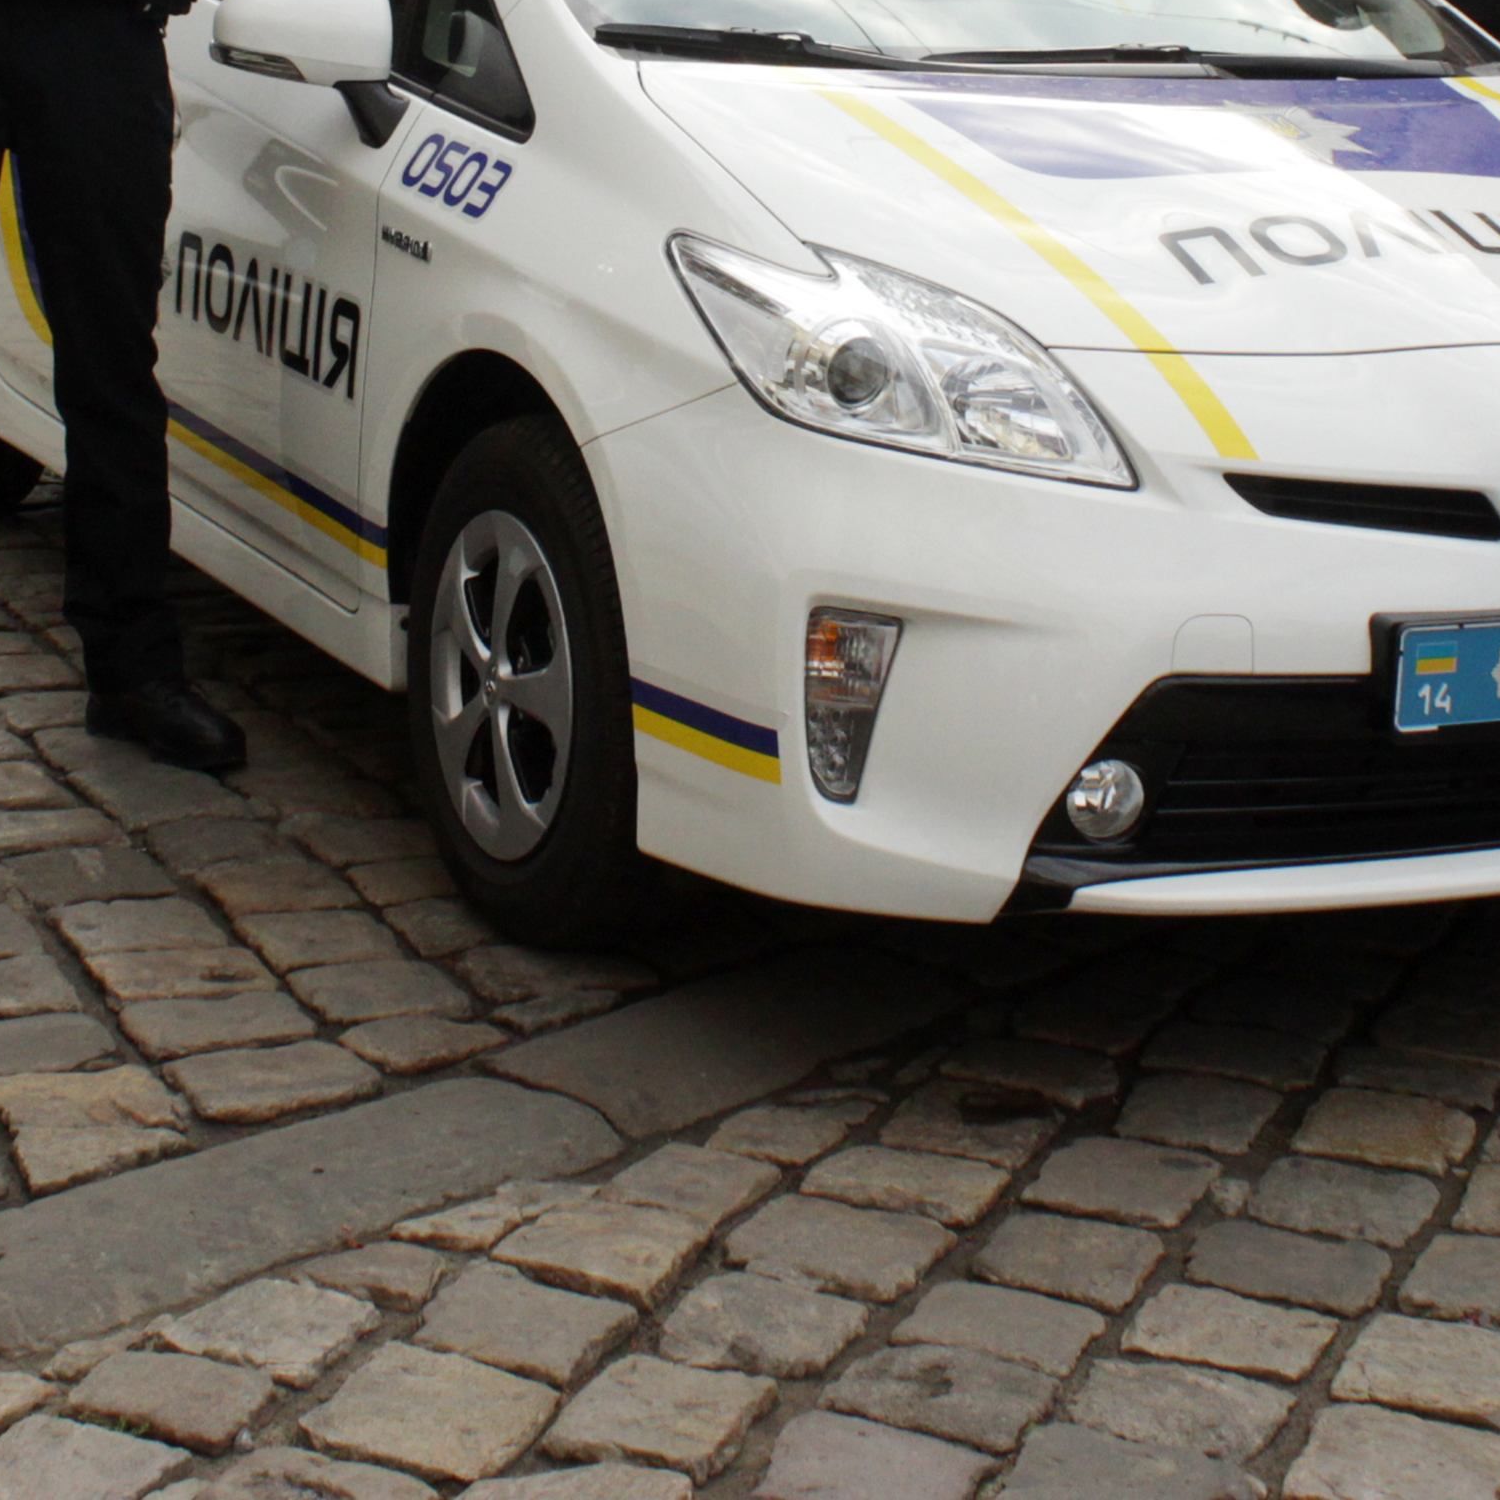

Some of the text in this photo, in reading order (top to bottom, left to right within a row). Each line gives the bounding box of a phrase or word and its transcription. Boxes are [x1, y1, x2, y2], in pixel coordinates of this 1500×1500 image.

[401, 132, 513, 219] 0503
[174, 230, 363, 399] ПОЛІЦІЯ
[1418, 681, 1453, 717] 14
